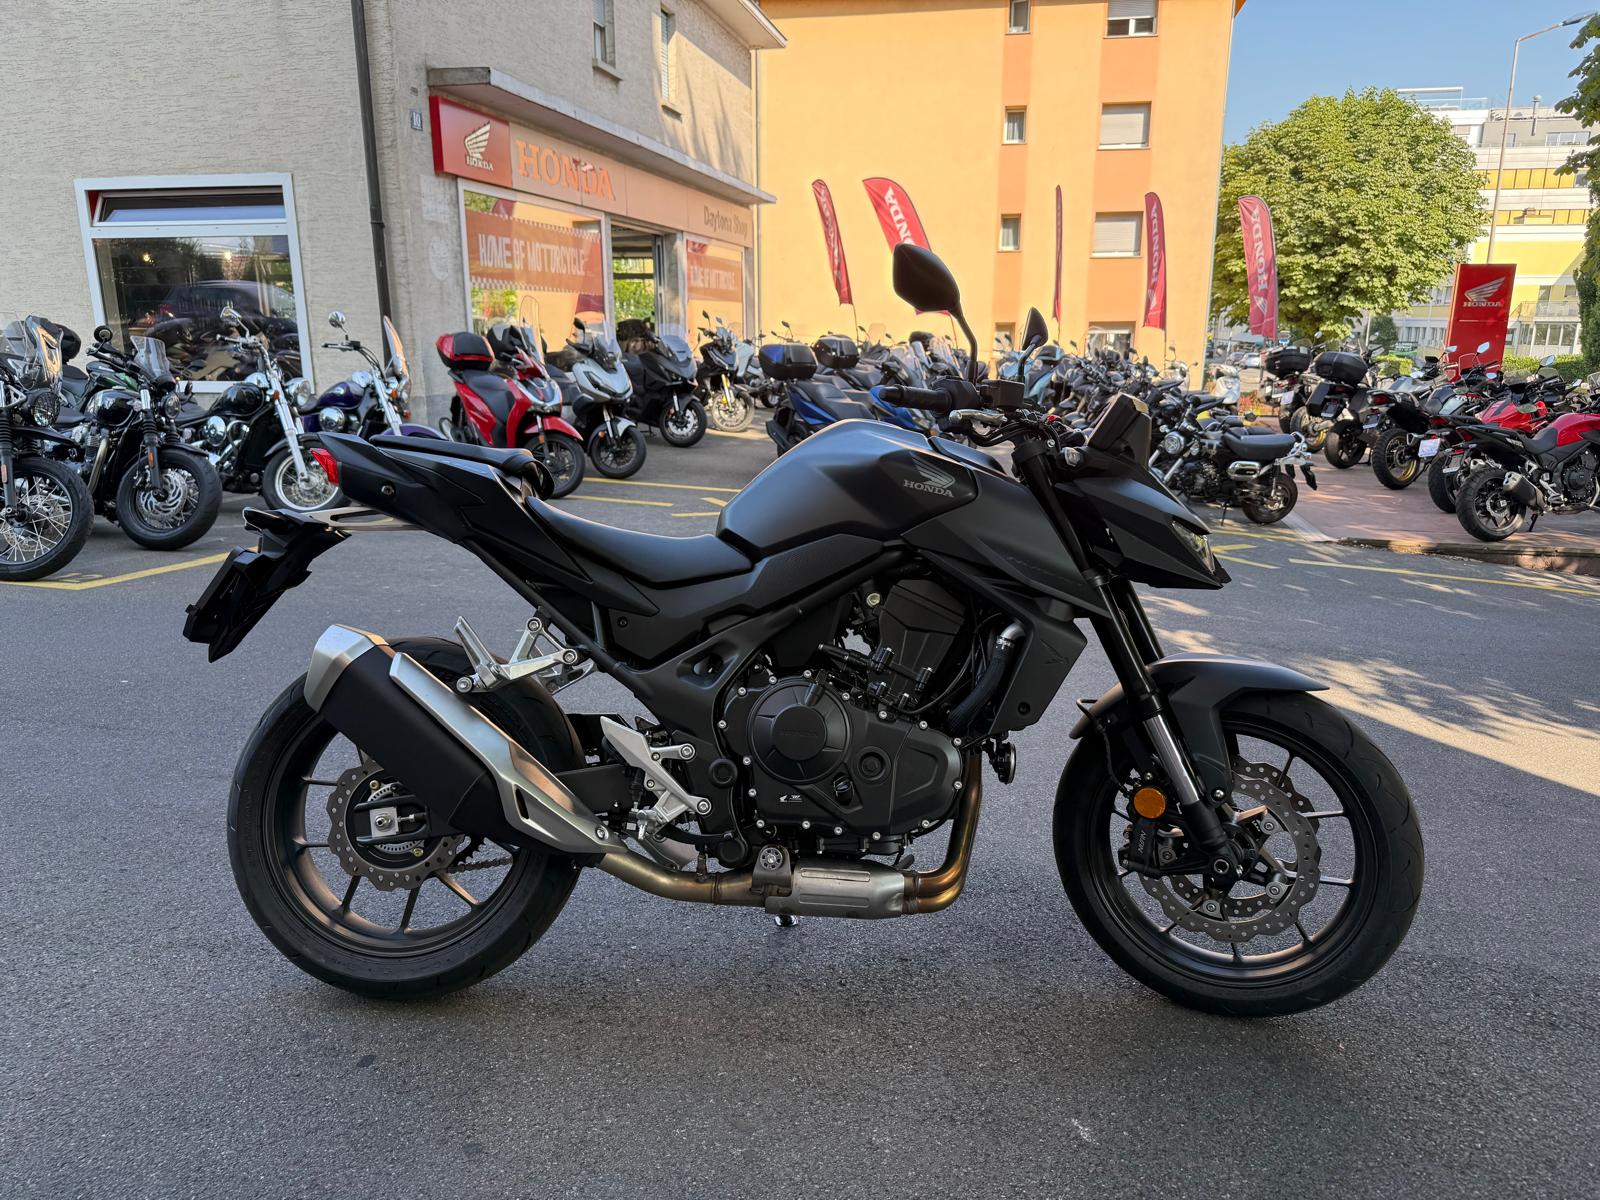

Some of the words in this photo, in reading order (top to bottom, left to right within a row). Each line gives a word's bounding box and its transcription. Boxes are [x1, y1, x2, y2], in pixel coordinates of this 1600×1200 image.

[466, 156, 493, 171] HONDA
[515, 140, 616, 201] HONDA
[884, 186, 915, 245] NDA
[1150, 202, 1160, 284] HONDA
[478, 233, 512, 269] HOME
[513, 238, 526, 271] OF
[1252, 205, 1268, 290] HONDA
[904, 479, 954, 498] HONDA
